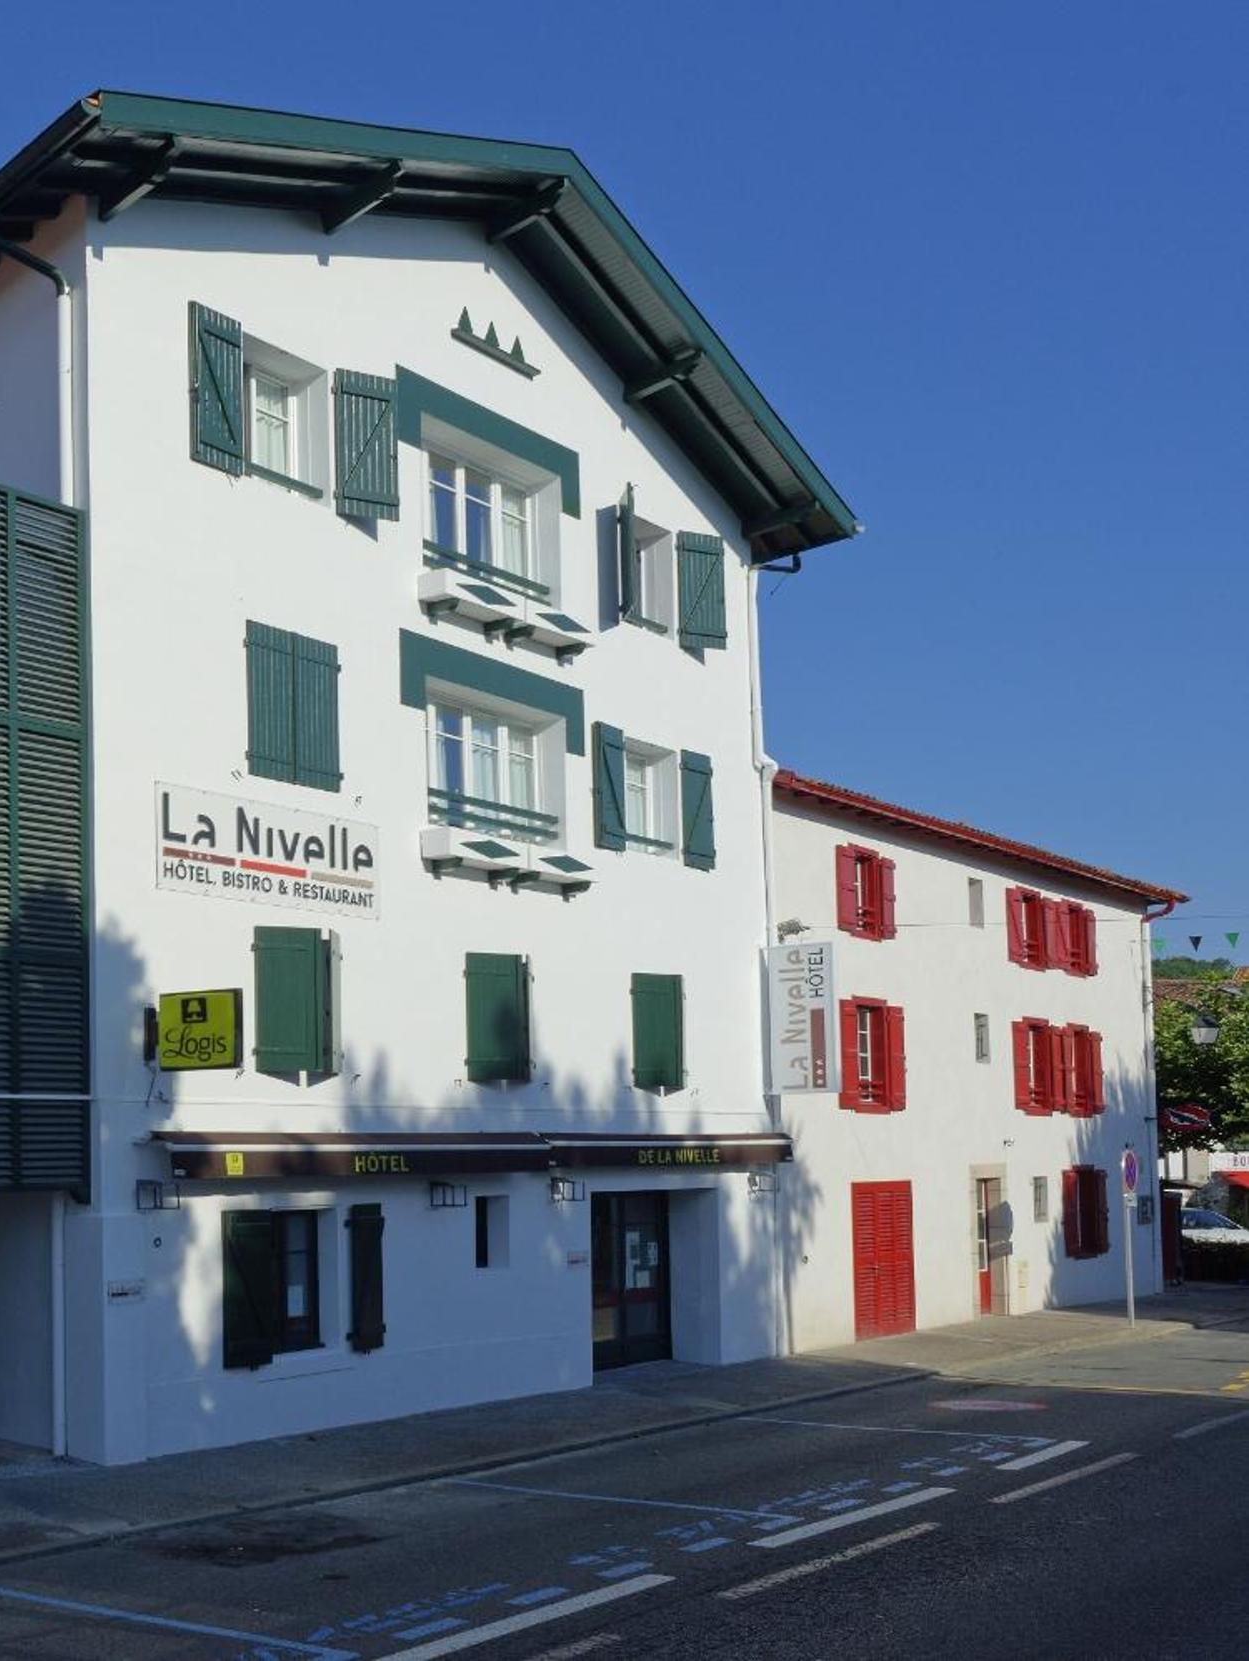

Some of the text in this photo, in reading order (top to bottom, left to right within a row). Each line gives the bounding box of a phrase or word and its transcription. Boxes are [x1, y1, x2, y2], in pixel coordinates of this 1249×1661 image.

[162, 791, 374, 872] La Nivelle
[163, 858, 374, 908] HÔTEL, BISTRO & RESTAURANT
[806, 947, 824, 999] HÔTEL
[162, 1025, 227, 1062] Logis
[778, 949, 808, 1090] La Nivelle
[354, 1151, 409, 1173] HÔTEL
[638, 1148, 720, 1164] DE LA NIVELLE
